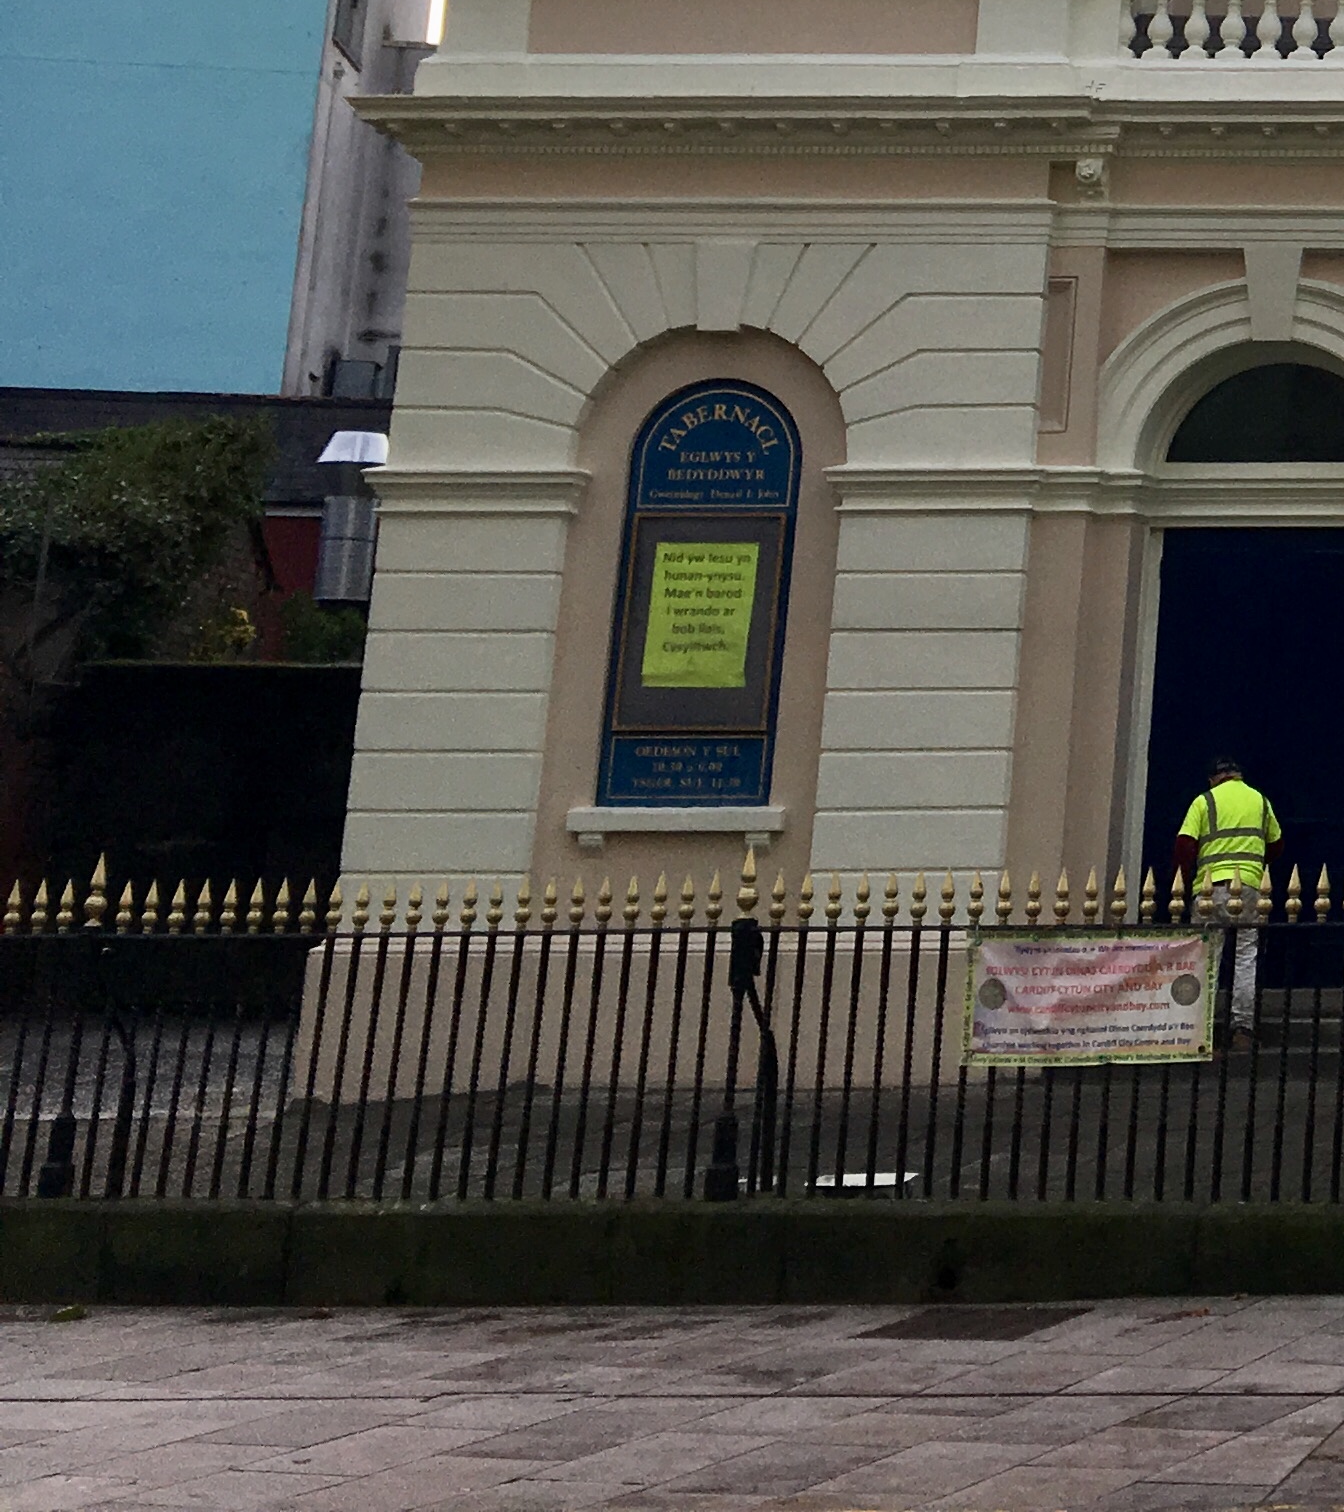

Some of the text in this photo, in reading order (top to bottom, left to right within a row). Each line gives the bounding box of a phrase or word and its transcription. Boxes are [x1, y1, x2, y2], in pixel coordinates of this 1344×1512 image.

[657, 404, 779, 456] TABERNACL
[680, 451, 741, 463] EGLWYS
[662, 552, 684, 563] Nid
